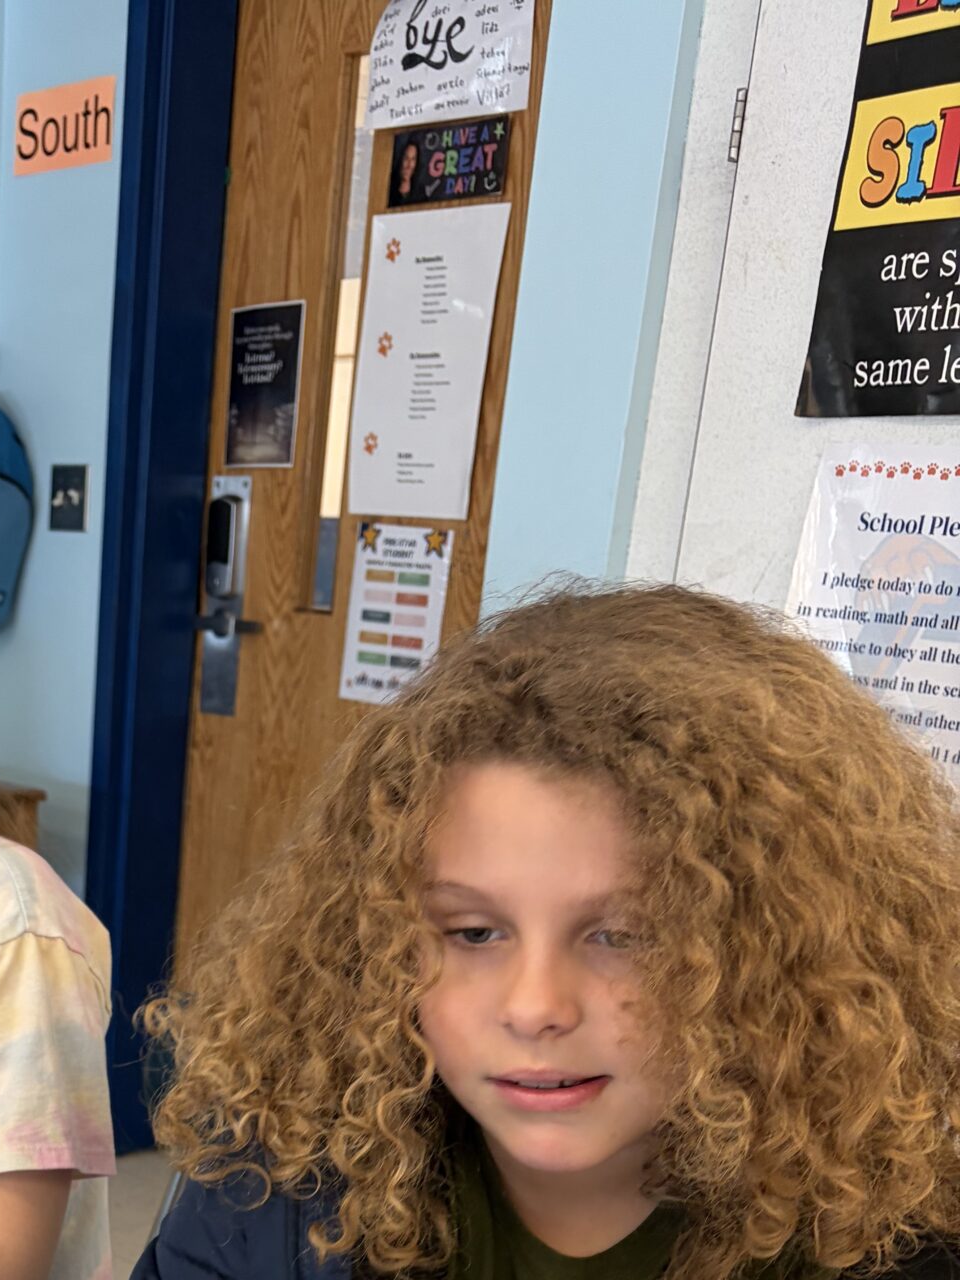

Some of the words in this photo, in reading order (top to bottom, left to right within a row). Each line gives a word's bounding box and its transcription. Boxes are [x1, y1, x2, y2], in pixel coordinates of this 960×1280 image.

[17, 94, 111, 161] South
[442, 128, 478, 147] HAVE
[480, 125, 490, 141] A
[428, 143, 498, 177] GREAT
[445, 176, 477, 193] DAY!
[880, 250, 930, 281] are
[893, 291, 960, 334] with
[853, 356, 930, 388] same
[858, 511, 926, 535] School
[830, 572, 875, 592] pledge
[877, 575, 916, 595] today
[918, 580, 932, 594] to
[935, 580, 953, 596] do
[797, 602, 812, 616] in
[874, 610, 908, 626] math
[911, 614, 939, 628] and
[941, 615, 960, 631] all
[812, 636, 867, 655] romise
[868, 641, 882, 656] to
[884, 643, 918, 662] obey
[919, 646, 938, 662] all
[872, 676, 899, 692] and
[901, 676, 915, 693] in
[917, 680, 941, 696] the
